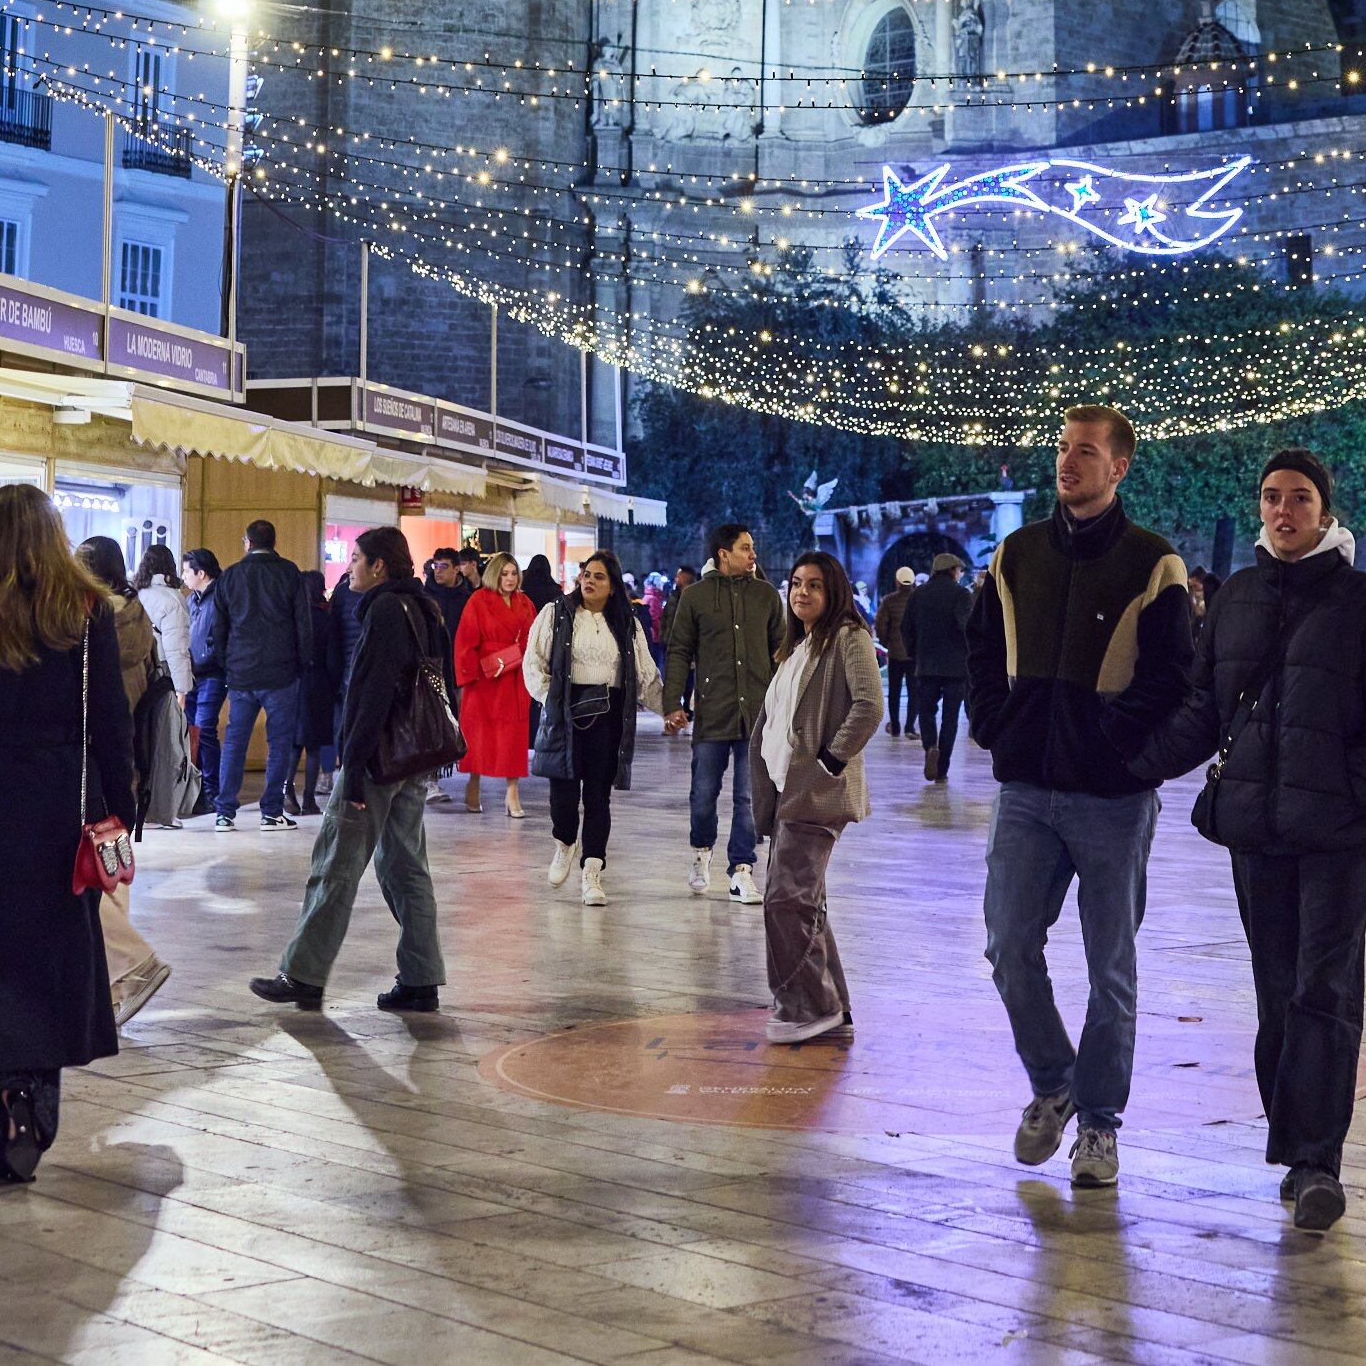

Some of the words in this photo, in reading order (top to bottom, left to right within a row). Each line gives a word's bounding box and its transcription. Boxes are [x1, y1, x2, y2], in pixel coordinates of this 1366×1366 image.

[8, 299, 21, 327] DE
[21, 306, 52, 334] BAMBÚ
[63, 335, 86, 354] HUESCA
[92, 331, 99, 347] 10
[126, 332, 137, 355] LA
[137, 334, 171, 364] MODERNA
[171, 344, 193, 369] VIDRIO
[194, 367, 218, 386] CANTABRIA
[222, 361, 227, 374] 11
[374, 396, 383, 414] LOS
